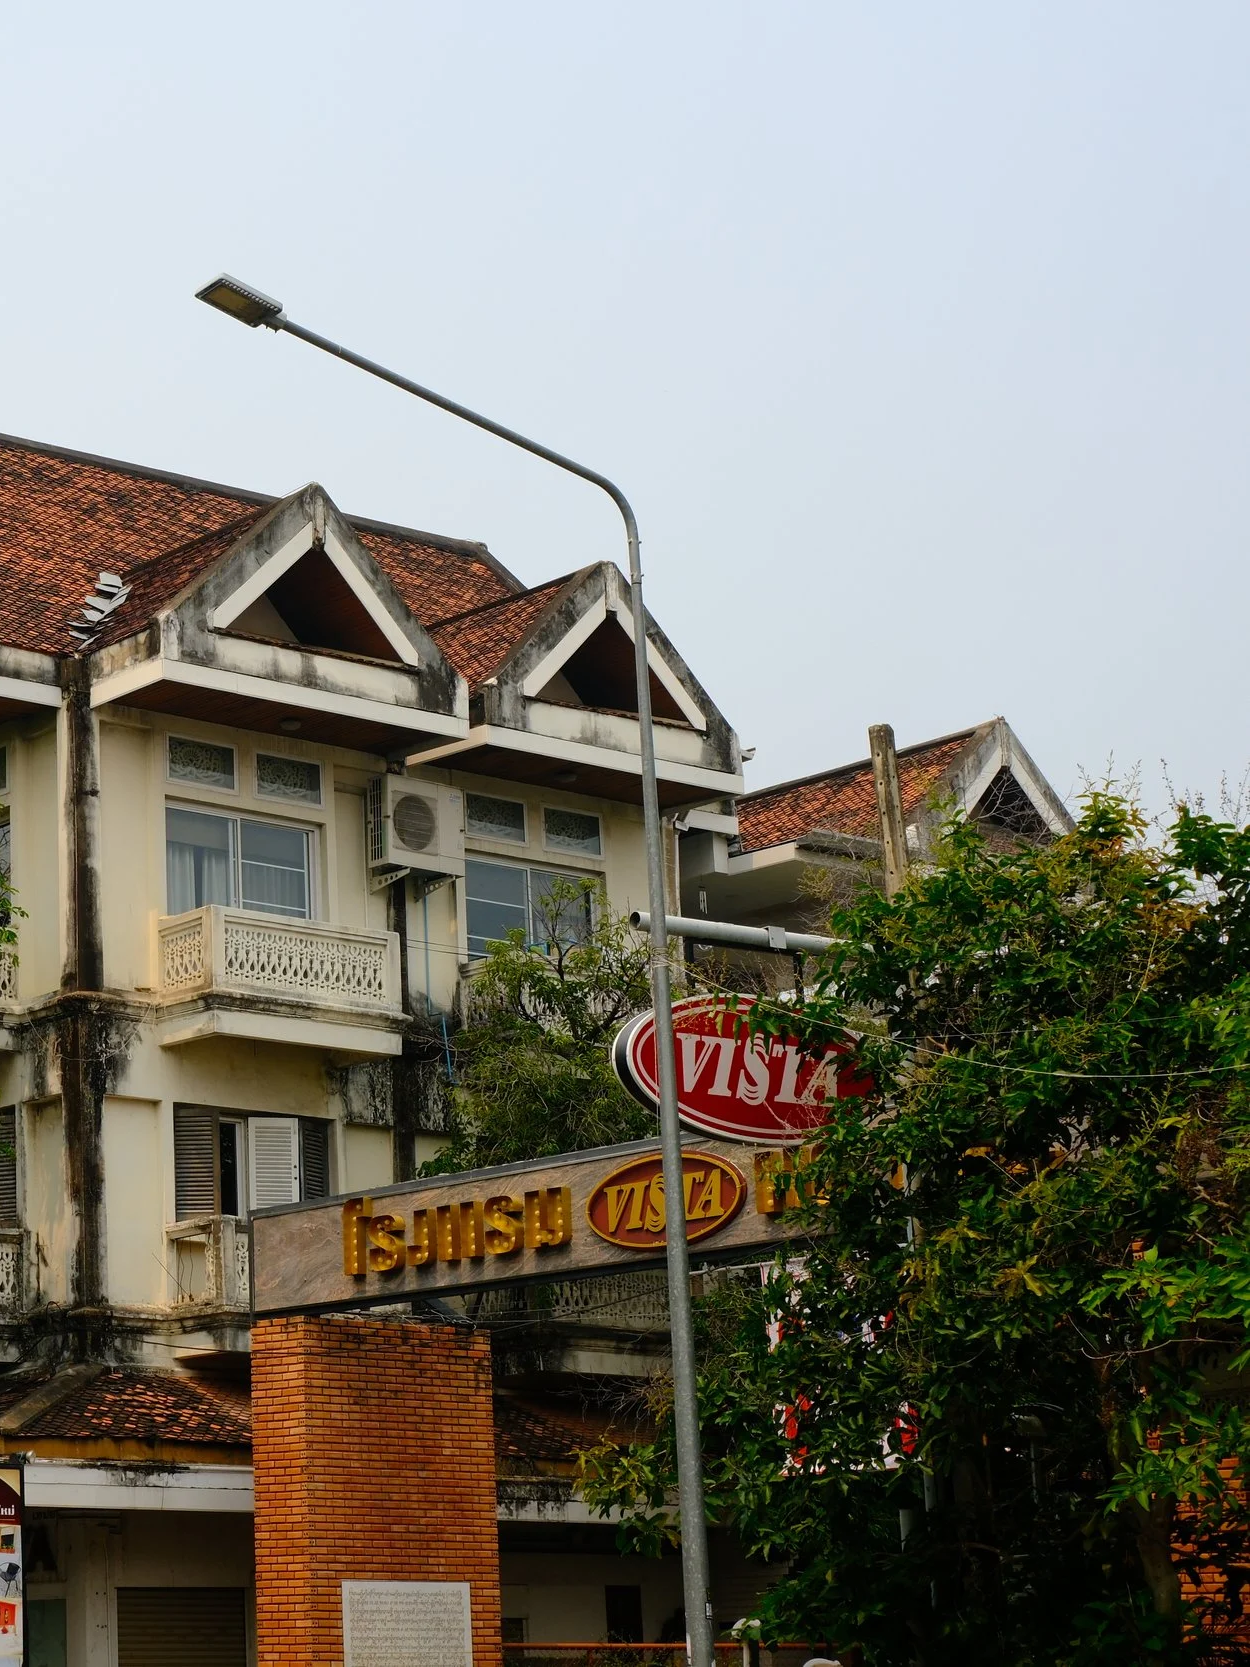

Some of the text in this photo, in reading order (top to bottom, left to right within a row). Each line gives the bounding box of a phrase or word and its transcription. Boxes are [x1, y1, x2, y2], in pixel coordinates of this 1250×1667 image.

[675, 1031, 838, 1107] VISTA
[342, 1186, 573, 1277] โรงแรม
